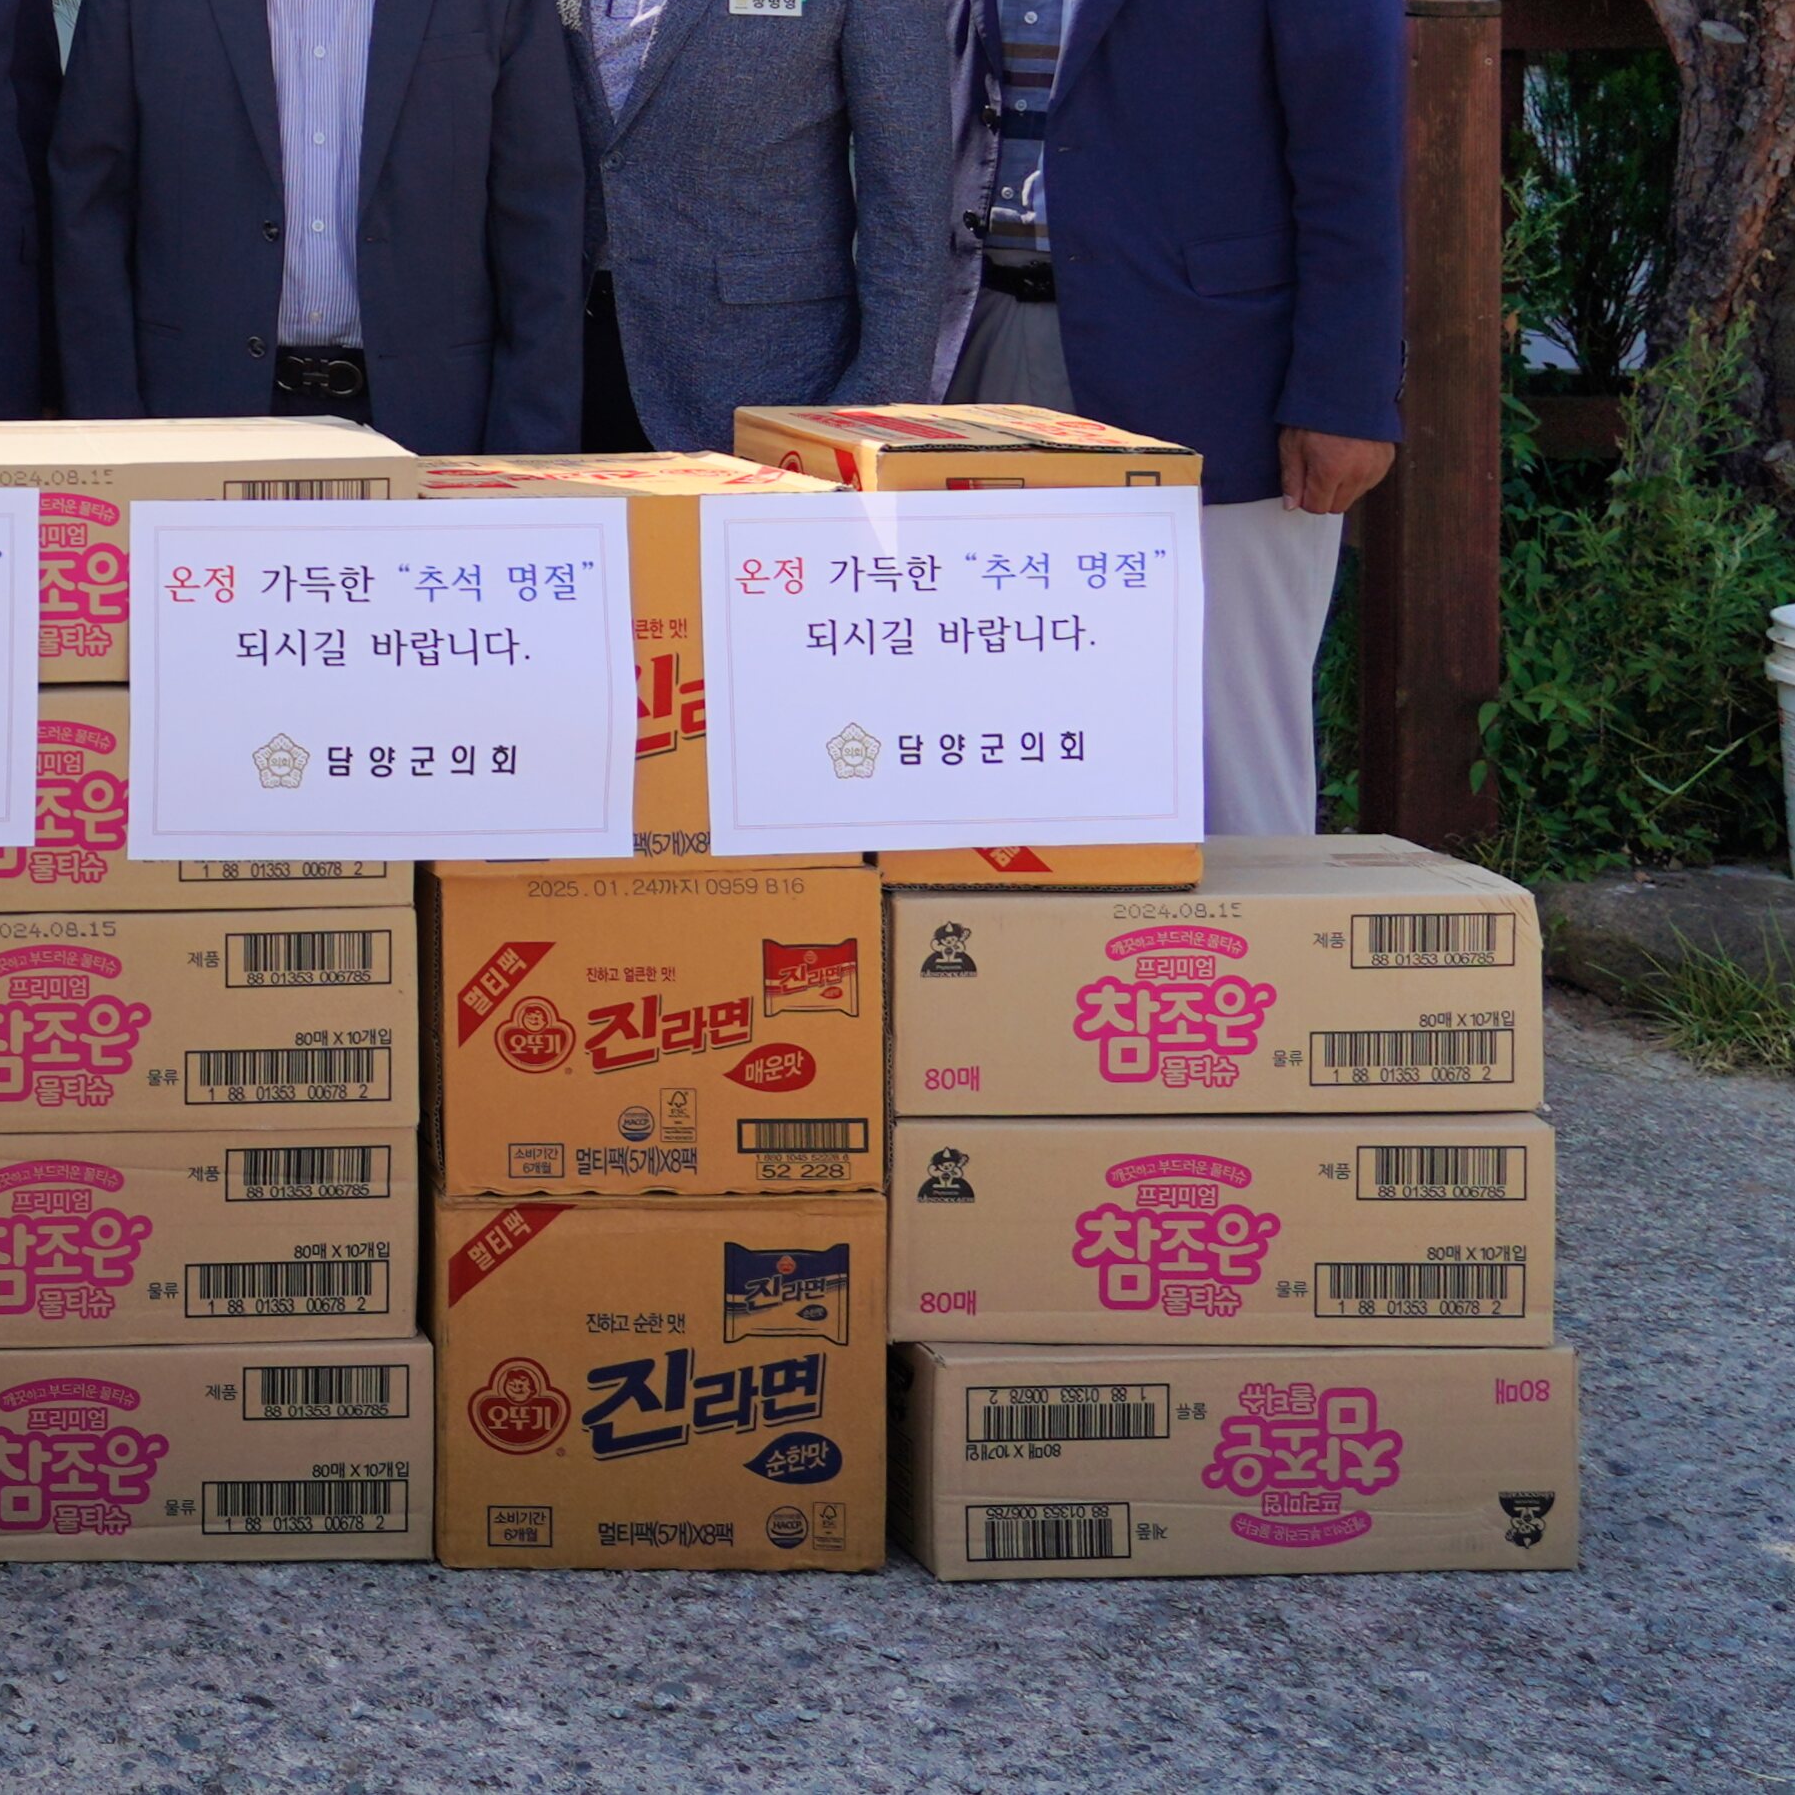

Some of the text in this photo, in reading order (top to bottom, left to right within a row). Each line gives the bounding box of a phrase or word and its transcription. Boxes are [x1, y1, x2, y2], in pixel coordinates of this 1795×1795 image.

[164, 559, 595, 604] 온정 가득한 “추석 명절”
[735, 548, 1167, 596] 온정 가득한 “추석 명절”
[669, 618, 688, 639] 맛!
[806, 615, 1097, 656] 되시길 바랍니다.
[39, 625, 112, 657] 물티슈
[236, 627, 531, 668] 되시길 바랍니다.
[706, 878, 758, 895] 0959
[1157, 931, 1205, 946] 부드러운
[29, 950, 80, 965] 부드러운
[187, 951, 220, 968] 제품
[1136, 956, 1216, 980] 프리미엄
[247, 970, 371, 985] 88 01353 006785
[462, 946, 529, 1015] 멀티팩
[586, 967, 676, 982] 진하고 얼큰한 맛!
[9, 977, 89, 999] 프리미엄
[295, 1032, 329, 1046] 80매
[346, 1028, 392, 1045] 10개입
[584, 994, 754, 1074] 진라면
[1076, 977, 1265, 1083] 참조은
[509, 1033, 562, 1055] 오뚜기
[147, 1069, 179, 1086] 물류
[744, 1052, 804, 1084] 매운맛
[925, 1065, 980, 1092] 80매
[1162, 1056, 1239, 1087] 물티슈
[36, 1074, 114, 1107] 물티슈
[514, 1147, 559, 1160] 소비기간
[33, 1165, 81, 1180] 부드러운
[188, 1166, 220, 1182] 제품
[522, 1162, 552, 1174] 6개월
[762, 1163, 845, 1179] 52 228
[13, 1190, 91, 1213] 프리미엄
[466, 1209, 533, 1271] 멀티팩
[38, 1286, 115, 1320] 물티슈
[147, 1283, 179, 1299] 물류
[742, 1277, 828, 1309] 진라면
[585, 1313, 686, 1333] 진하고 순한 맛!
[1239, 1382, 1316, 1416] 물티슈
[1495, 1378, 1550, 1405] 80매
[581, 1347, 827, 1461] 진라면
[28, 1408, 107, 1431] 프리미엄
[487, 1404, 552, 1432] 오뚜기
[1214, 1388, 1403, 1496] 참조은
[764, 1443, 829, 1477] 순한맛
[1262, 1492, 1341, 1516] 프리미엄
[53, 1502, 132, 1536] 물티슈
[493, 1511, 546, 1526] 소비기간
[503, 1527, 538, 1542] 6개월
